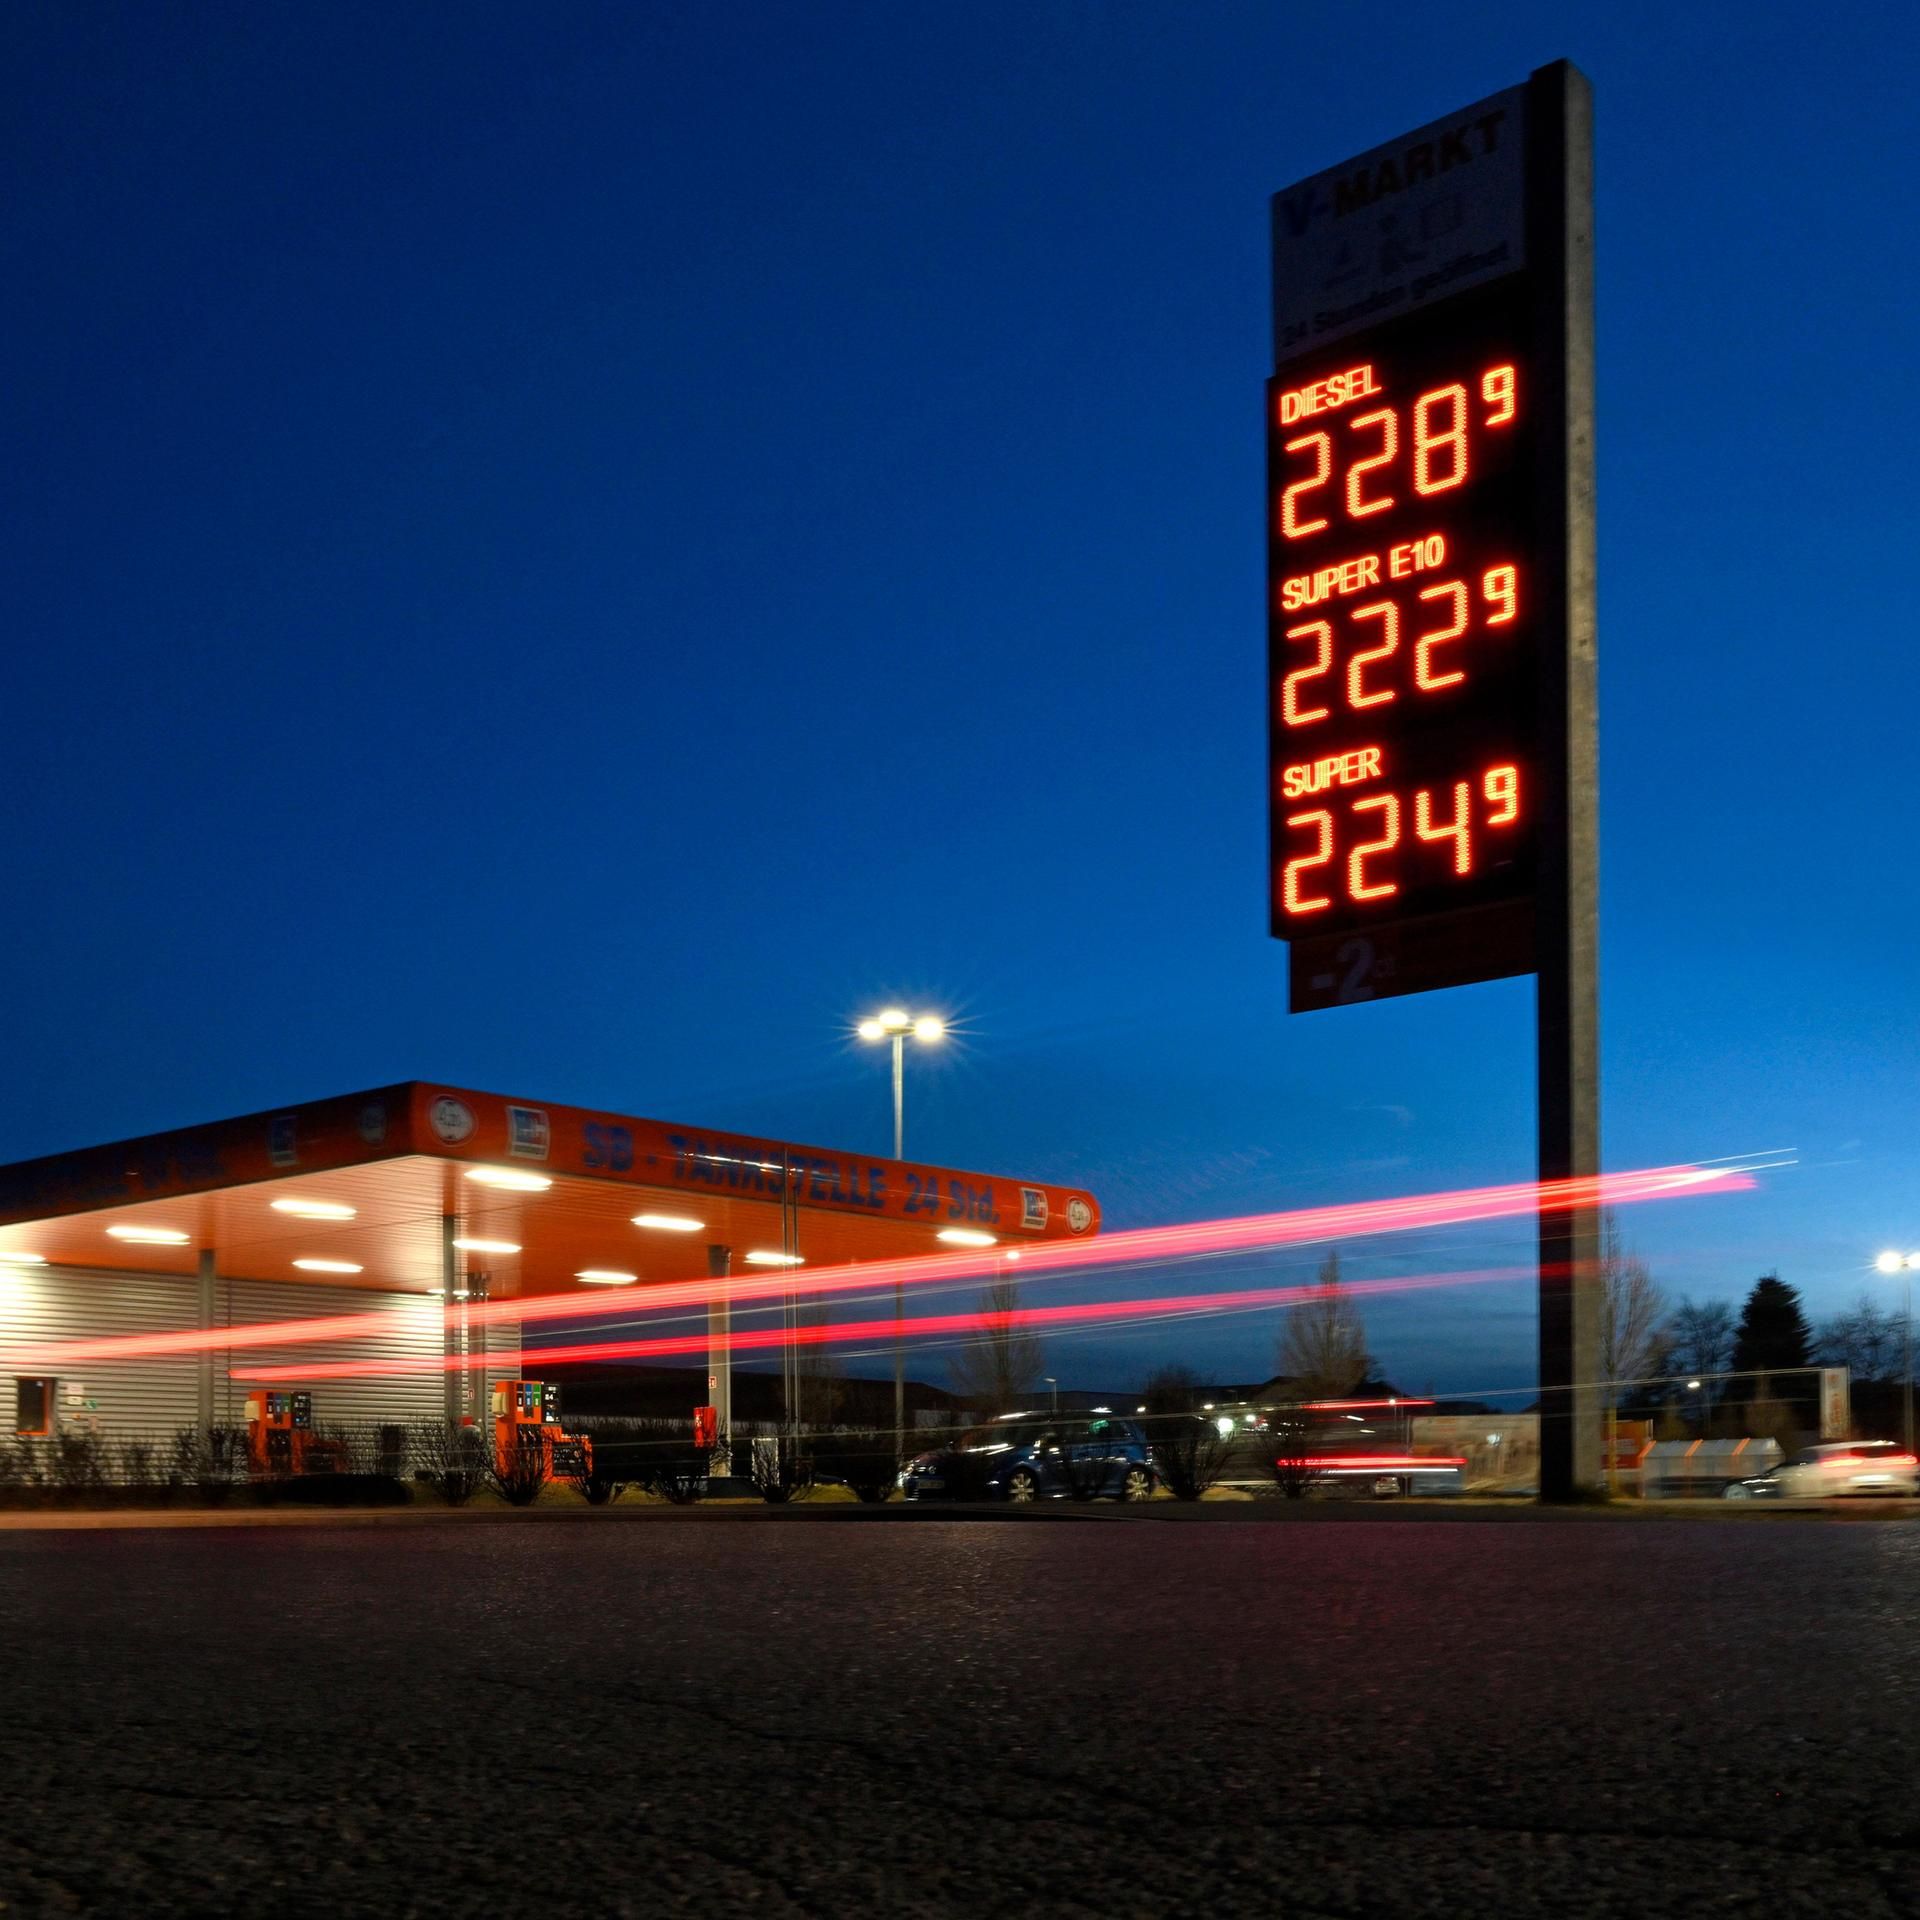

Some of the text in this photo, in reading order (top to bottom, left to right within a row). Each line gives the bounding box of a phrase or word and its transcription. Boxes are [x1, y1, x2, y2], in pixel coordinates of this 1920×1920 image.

[1280, 364, 1382, 425] DIESEL
[1281, 533, 1446, 611] SUPER E10
[1282, 746, 1382, 798] SUPER
[902, 1171, 941, 1214] 24
